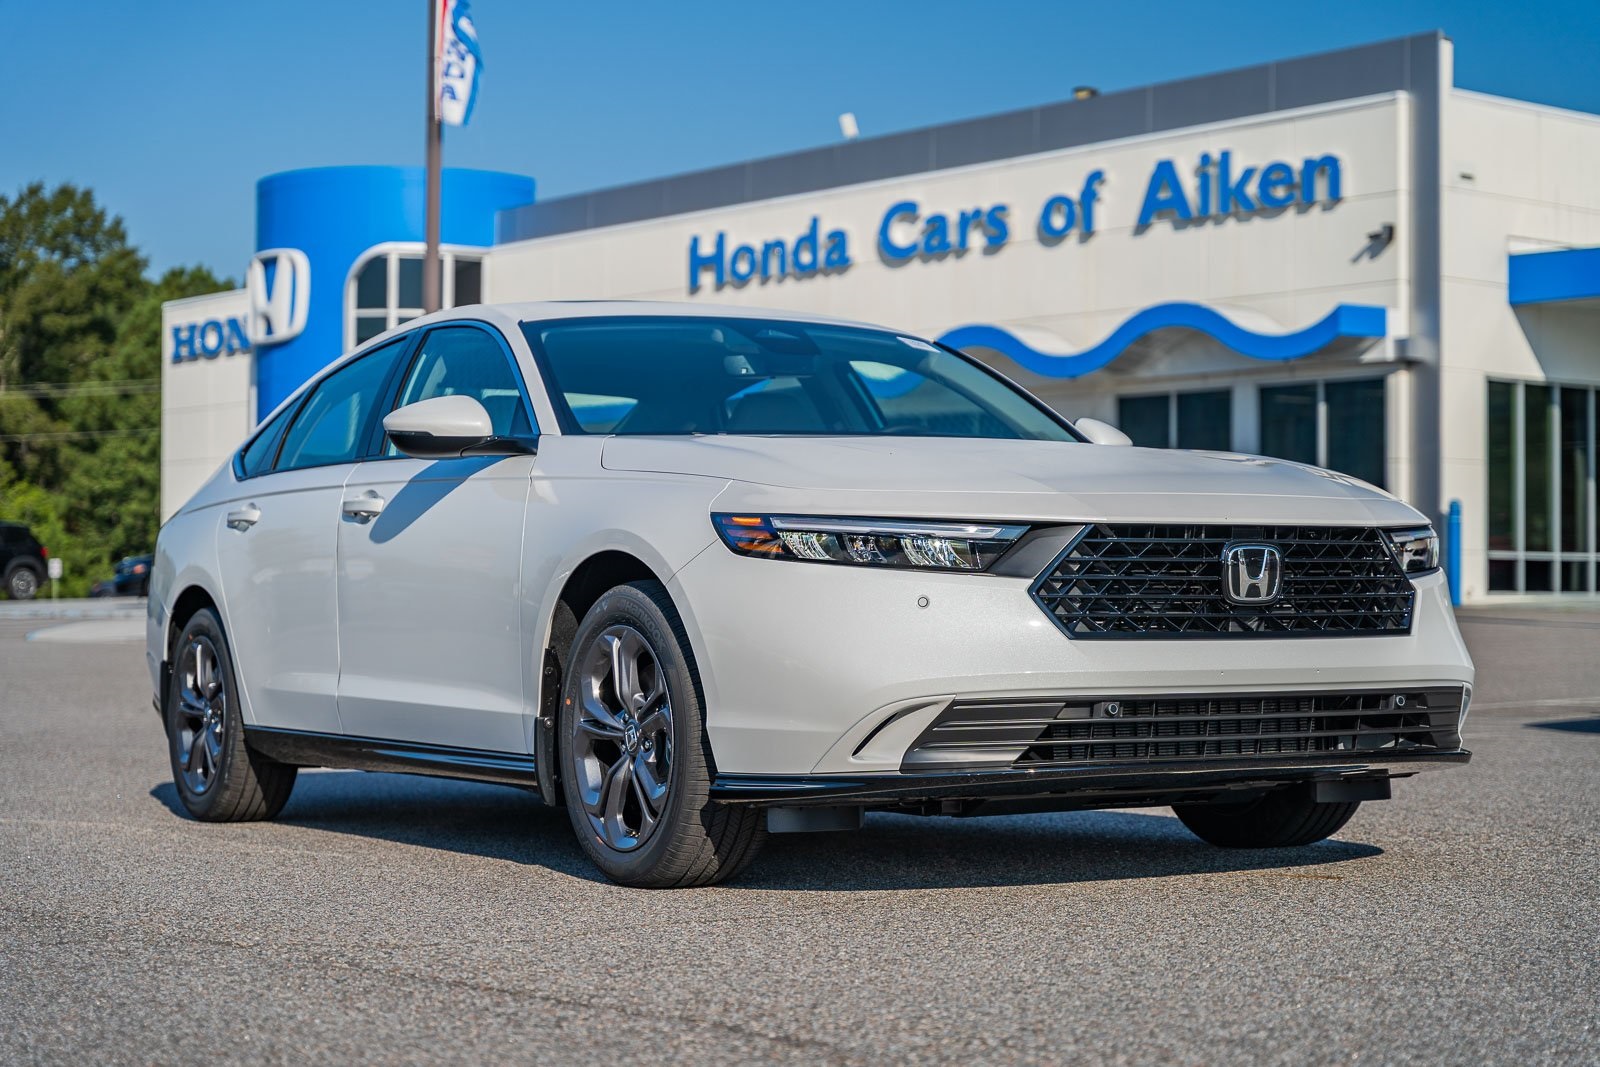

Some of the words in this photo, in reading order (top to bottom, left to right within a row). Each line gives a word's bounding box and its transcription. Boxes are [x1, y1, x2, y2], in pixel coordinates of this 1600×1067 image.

[688, 215, 850, 290] Honda
[879, 201, 1009, 260] Cars
[1040, 169, 1105, 239] of
[1136, 149, 1341, 226] Aiken
